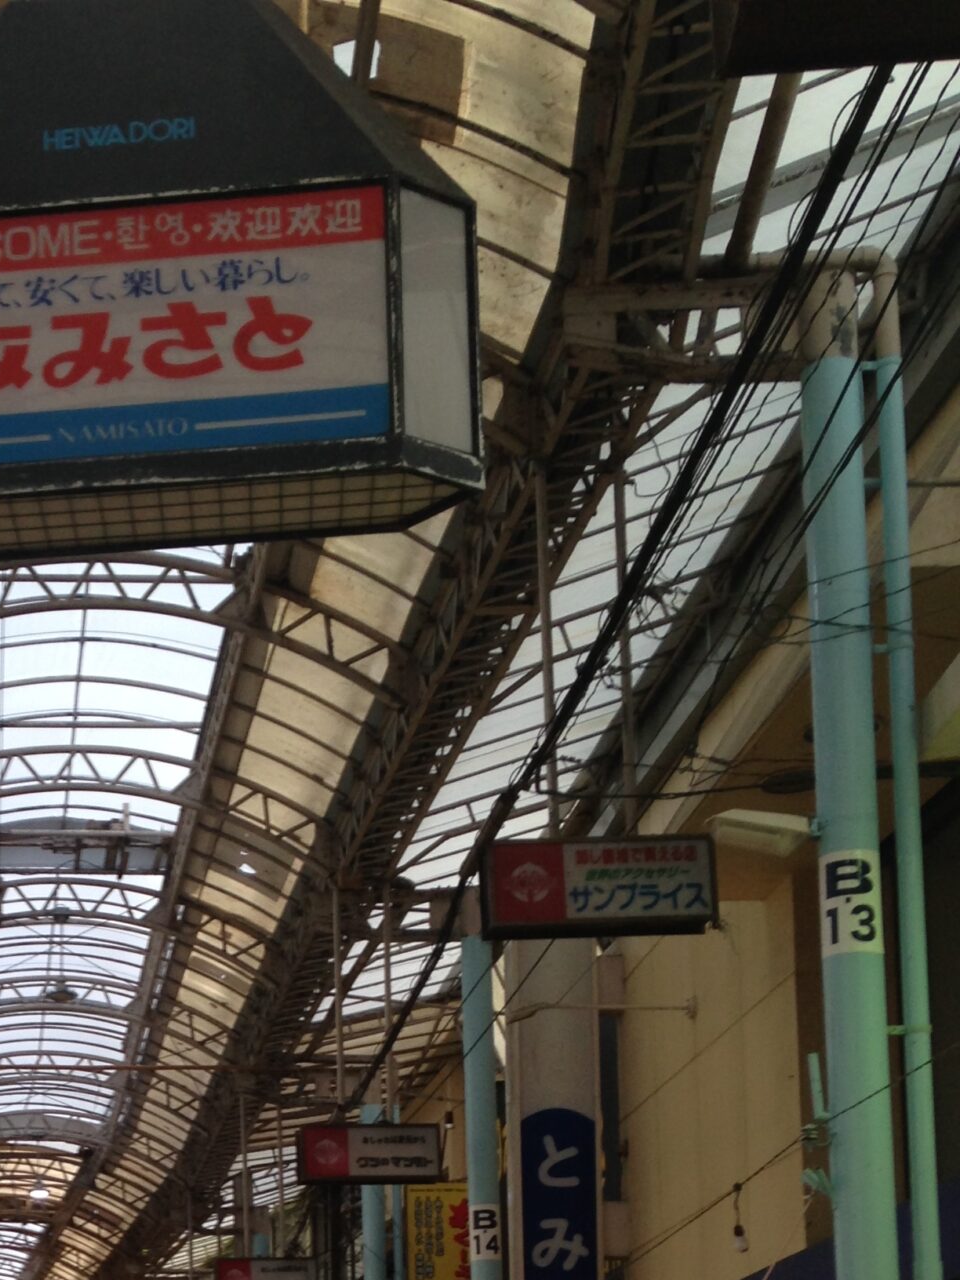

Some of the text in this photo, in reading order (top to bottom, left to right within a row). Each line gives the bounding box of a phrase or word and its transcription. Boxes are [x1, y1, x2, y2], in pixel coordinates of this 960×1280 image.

[44, 117, 196, 152] HEIWA DORI
[59, 416, 189, 444] NAMISATO
[825, 858, 874, 900] B
[826, 903, 877, 945] 13
[473, 1209, 497, 1230] B
[473, 1235, 499, 1255] 14
